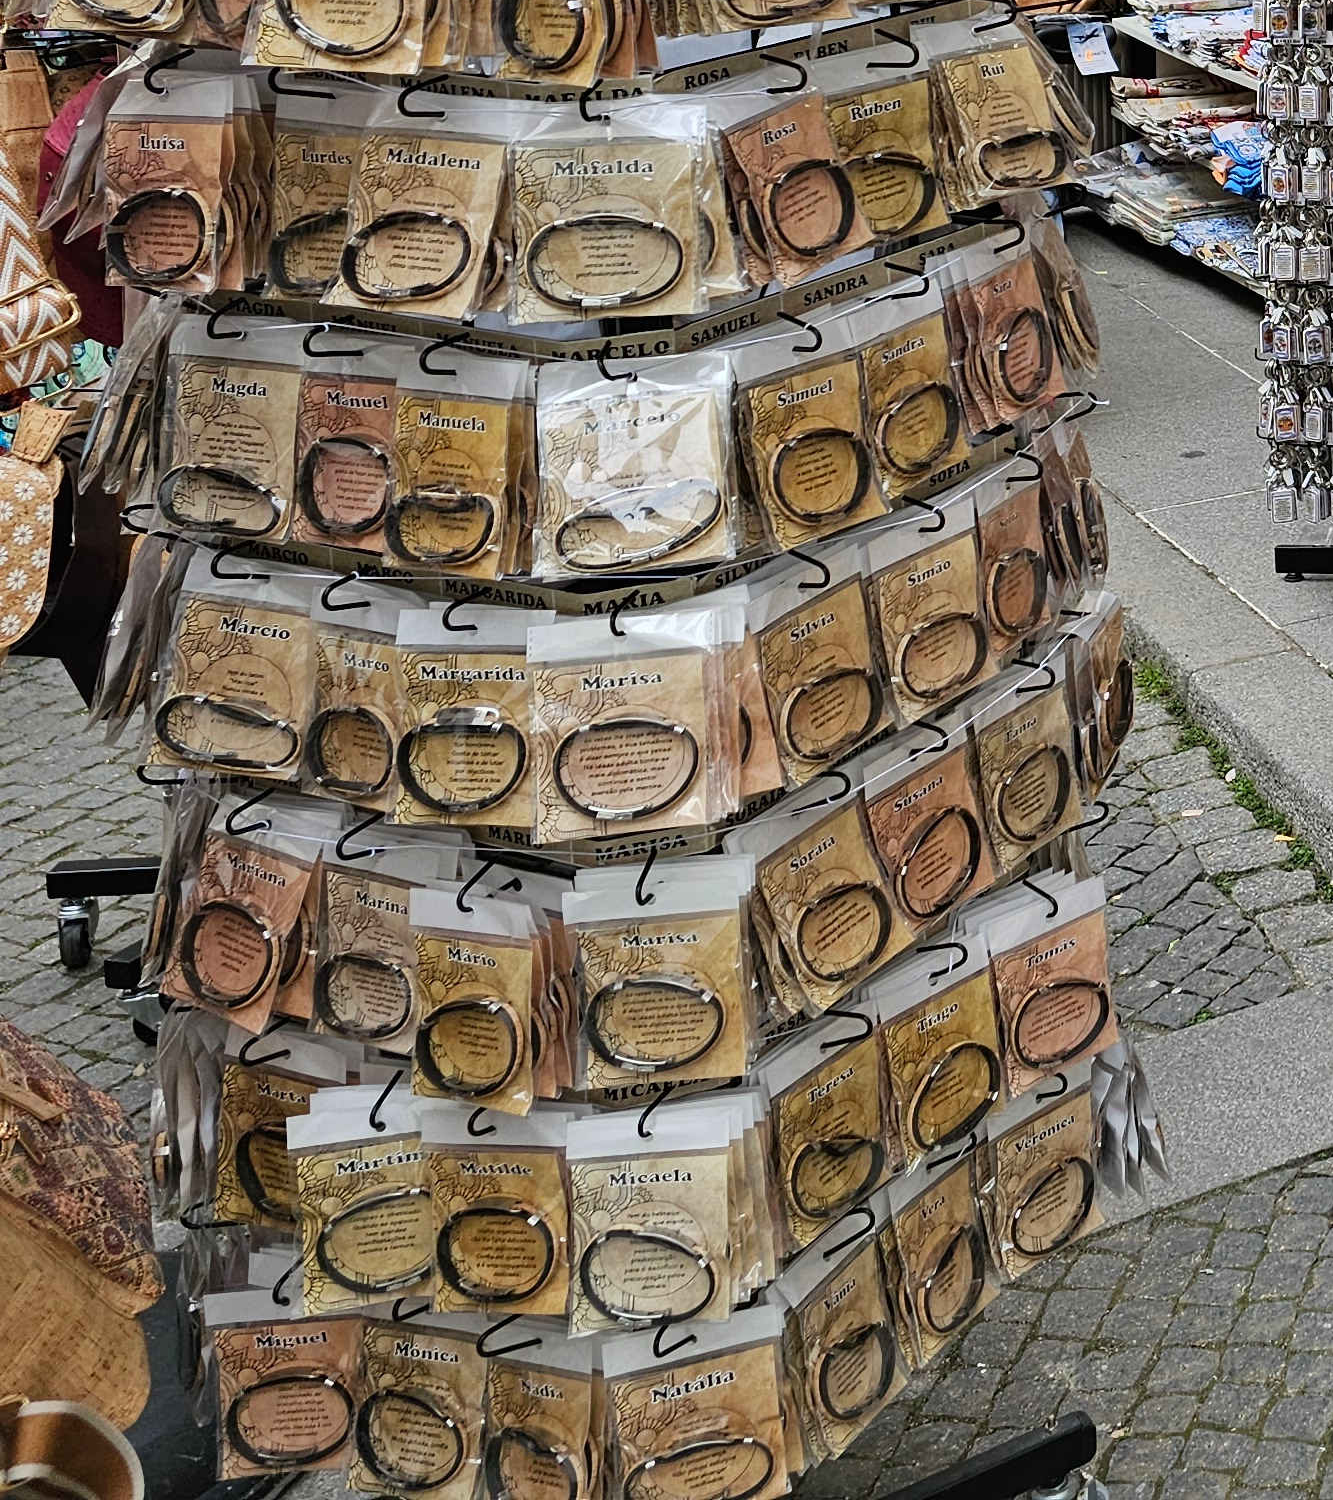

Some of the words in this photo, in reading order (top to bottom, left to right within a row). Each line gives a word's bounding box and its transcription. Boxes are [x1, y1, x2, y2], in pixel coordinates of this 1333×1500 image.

[684, 67, 731, 90] ROSA
[980, 62, 1005, 78] Rui
[763, 120, 797, 146] Rosa
[301, 147, 352, 165] Lurdes
[385, 147, 482, 171] Madalena
[553, 159, 654, 178] Mafalda
[229, 299, 286, 317] MAGDA
[690, 311, 761, 346] SAMUEL
[803, 273, 869, 306] SANDRA
[551, 340, 670, 363] MARCELO
[882, 336, 926, 365] Sandra
[211, 376, 267, 399] Magda
[776, 379, 834, 408] Samuel
[326, 391, 389, 411] Manuel
[418, 411, 486, 433] Manuela
[928, 460, 971, 488] SOFIA
[906, 557, 952, 588] Simão
[444, 578, 547, 611] MARGARIDA
[219, 617, 291, 641] Márcio
[343, 651, 390, 673] Marco
[420, 664, 526, 687] Margarida
[581, 669, 664, 692] Marisa
[893, 774, 944, 813] Susana
[595, 833, 689, 862] MARISA
[789, 834, 837, 875] Soraia
[224, 853, 287, 889] Mariana
[355, 891, 408, 916] Marina
[622, 932, 698, 949] Marisa
[446, 945, 497, 969] Mário
[1024, 937, 1077, 969] Tomás
[916, 1002, 959, 1034] Tiago
[256, 1082, 306, 1104] Marta
[807, 1064, 855, 1104] Teresa
[458, 1161, 532, 1177] Matilde
[608, 1170, 693, 1187] Micaela
[920, 1194, 945, 1220] Vera
[255, 1331, 329, 1350] Miguel
[394, 1342, 459, 1365] Mónica
[650, 1370, 735, 1403] Natália
